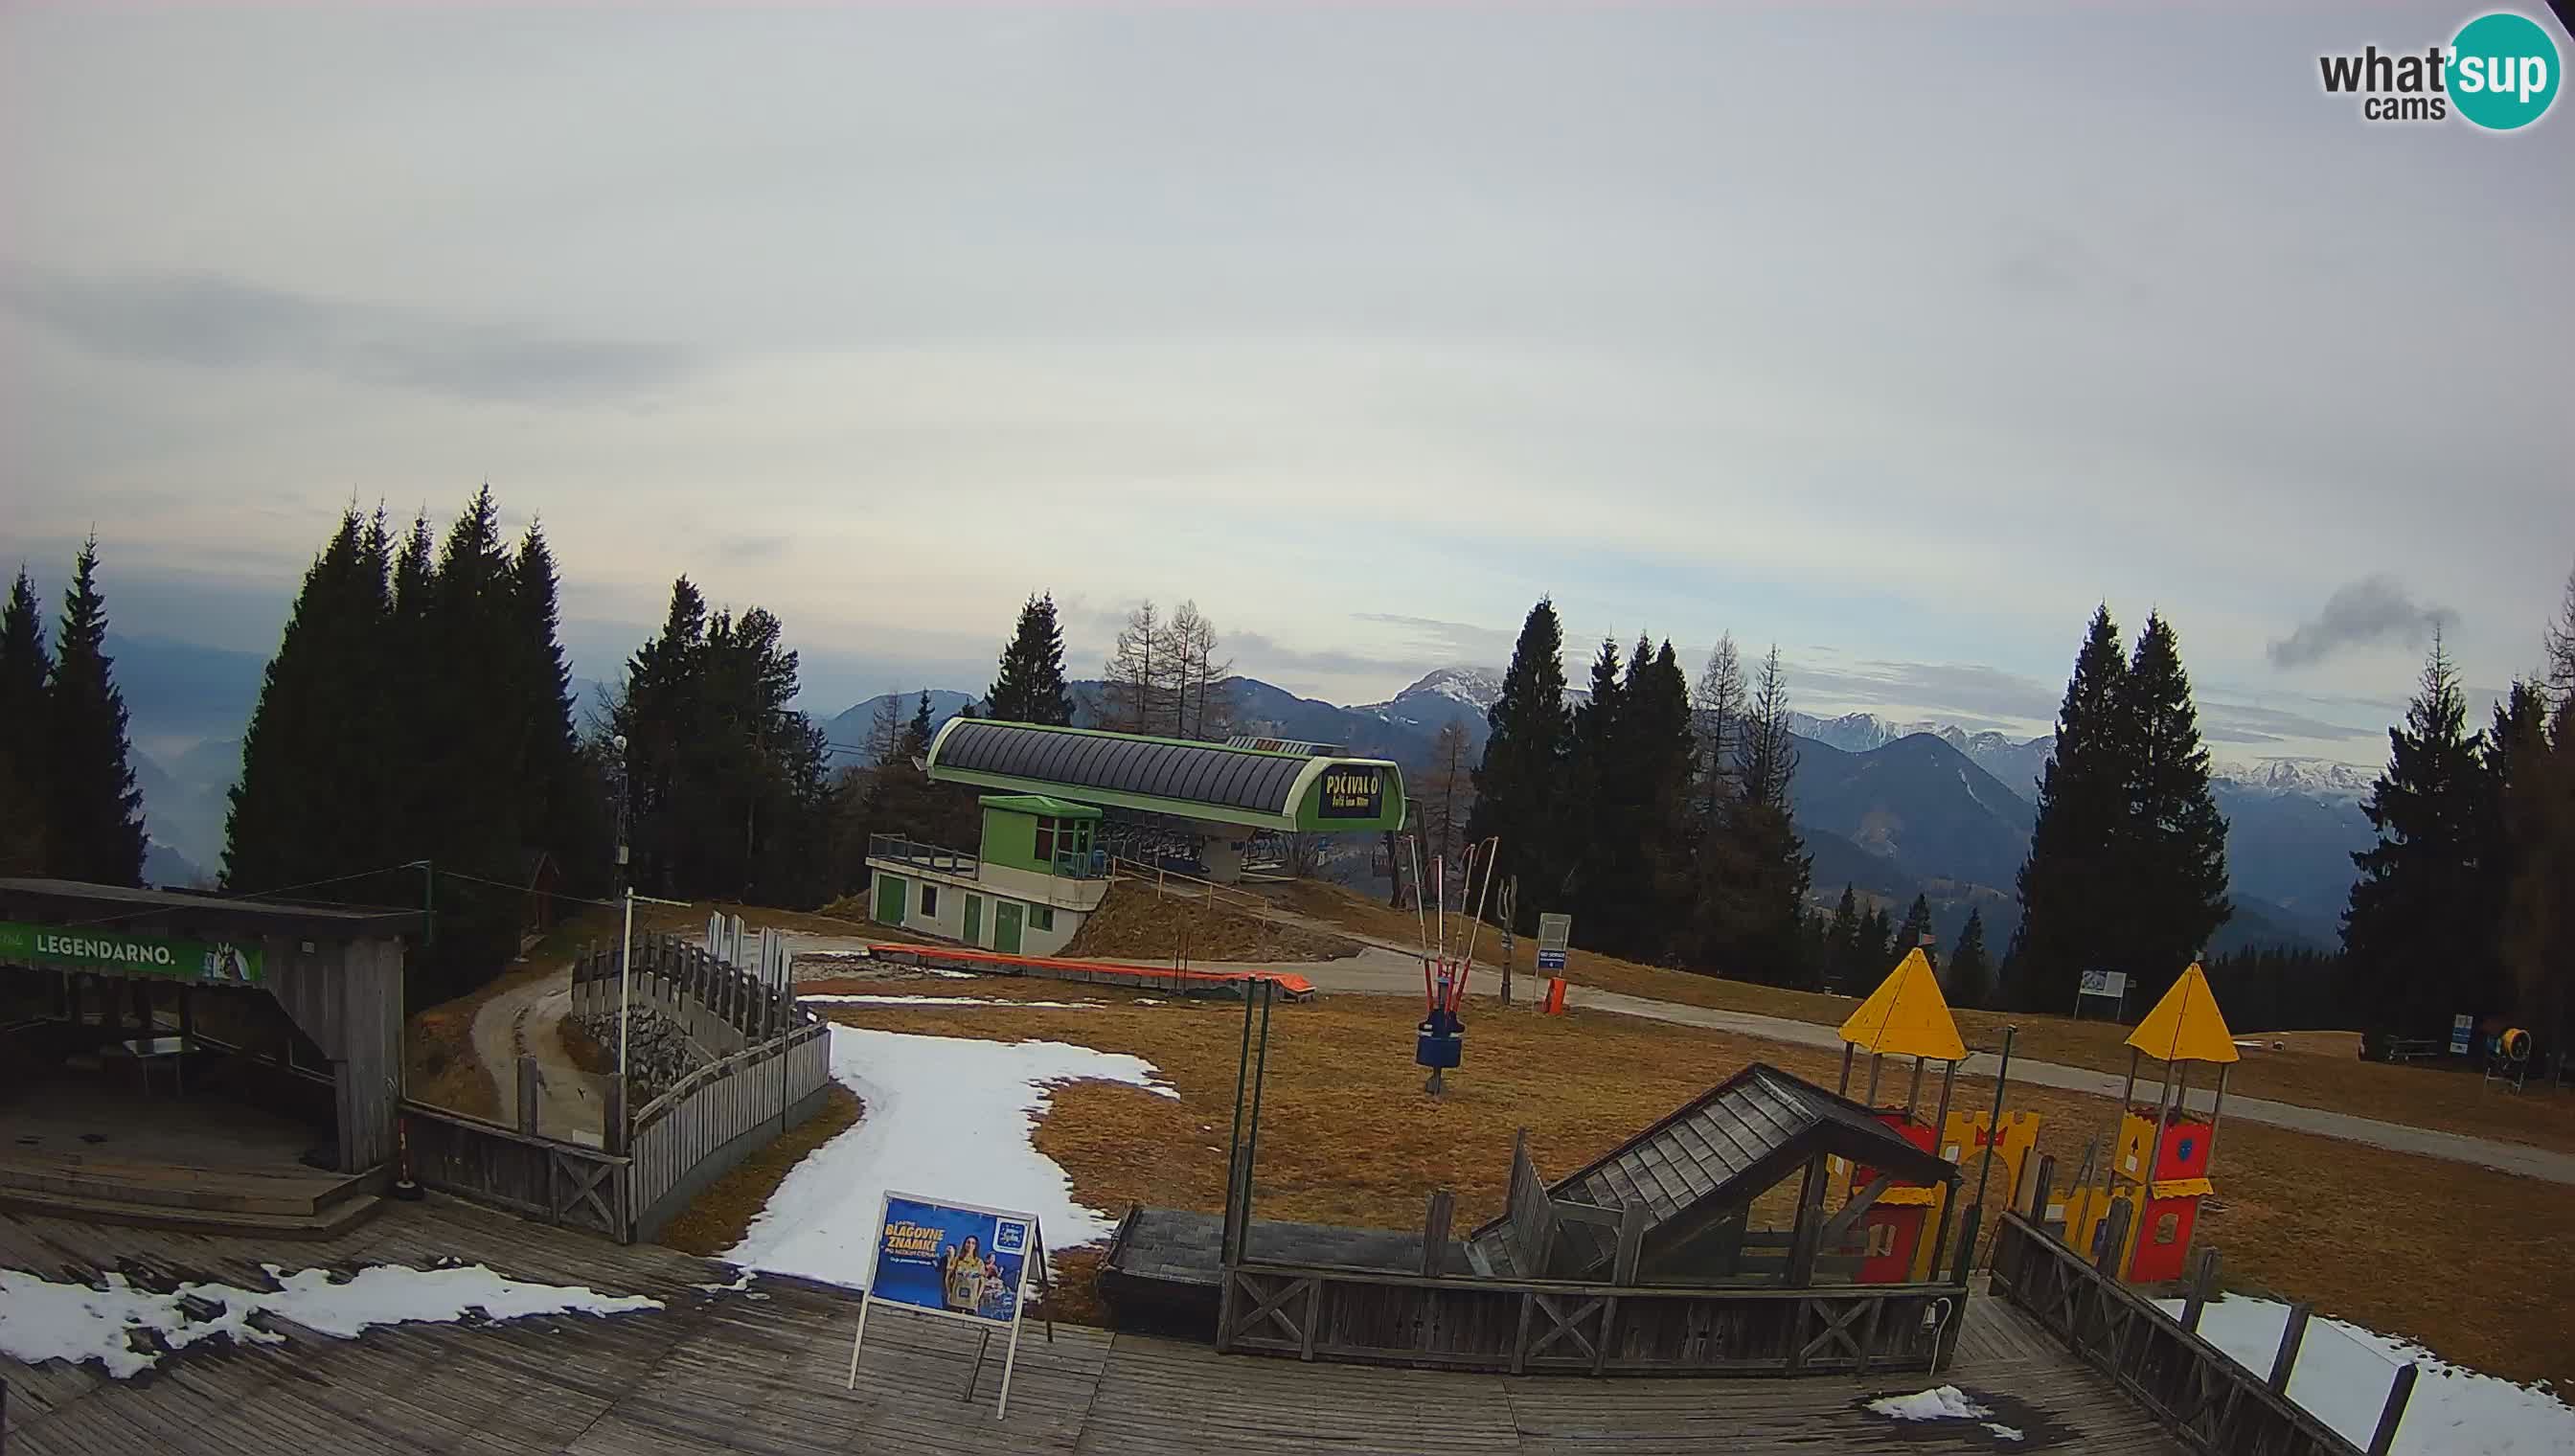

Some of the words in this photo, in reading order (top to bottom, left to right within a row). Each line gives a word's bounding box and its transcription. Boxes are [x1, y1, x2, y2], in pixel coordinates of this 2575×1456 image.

[36, 934, 176, 966] LEGENDARNO.
[885, 1224, 946, 1241] BLAGOVNE
[887, 1236, 938, 1252] ZNAMKE
